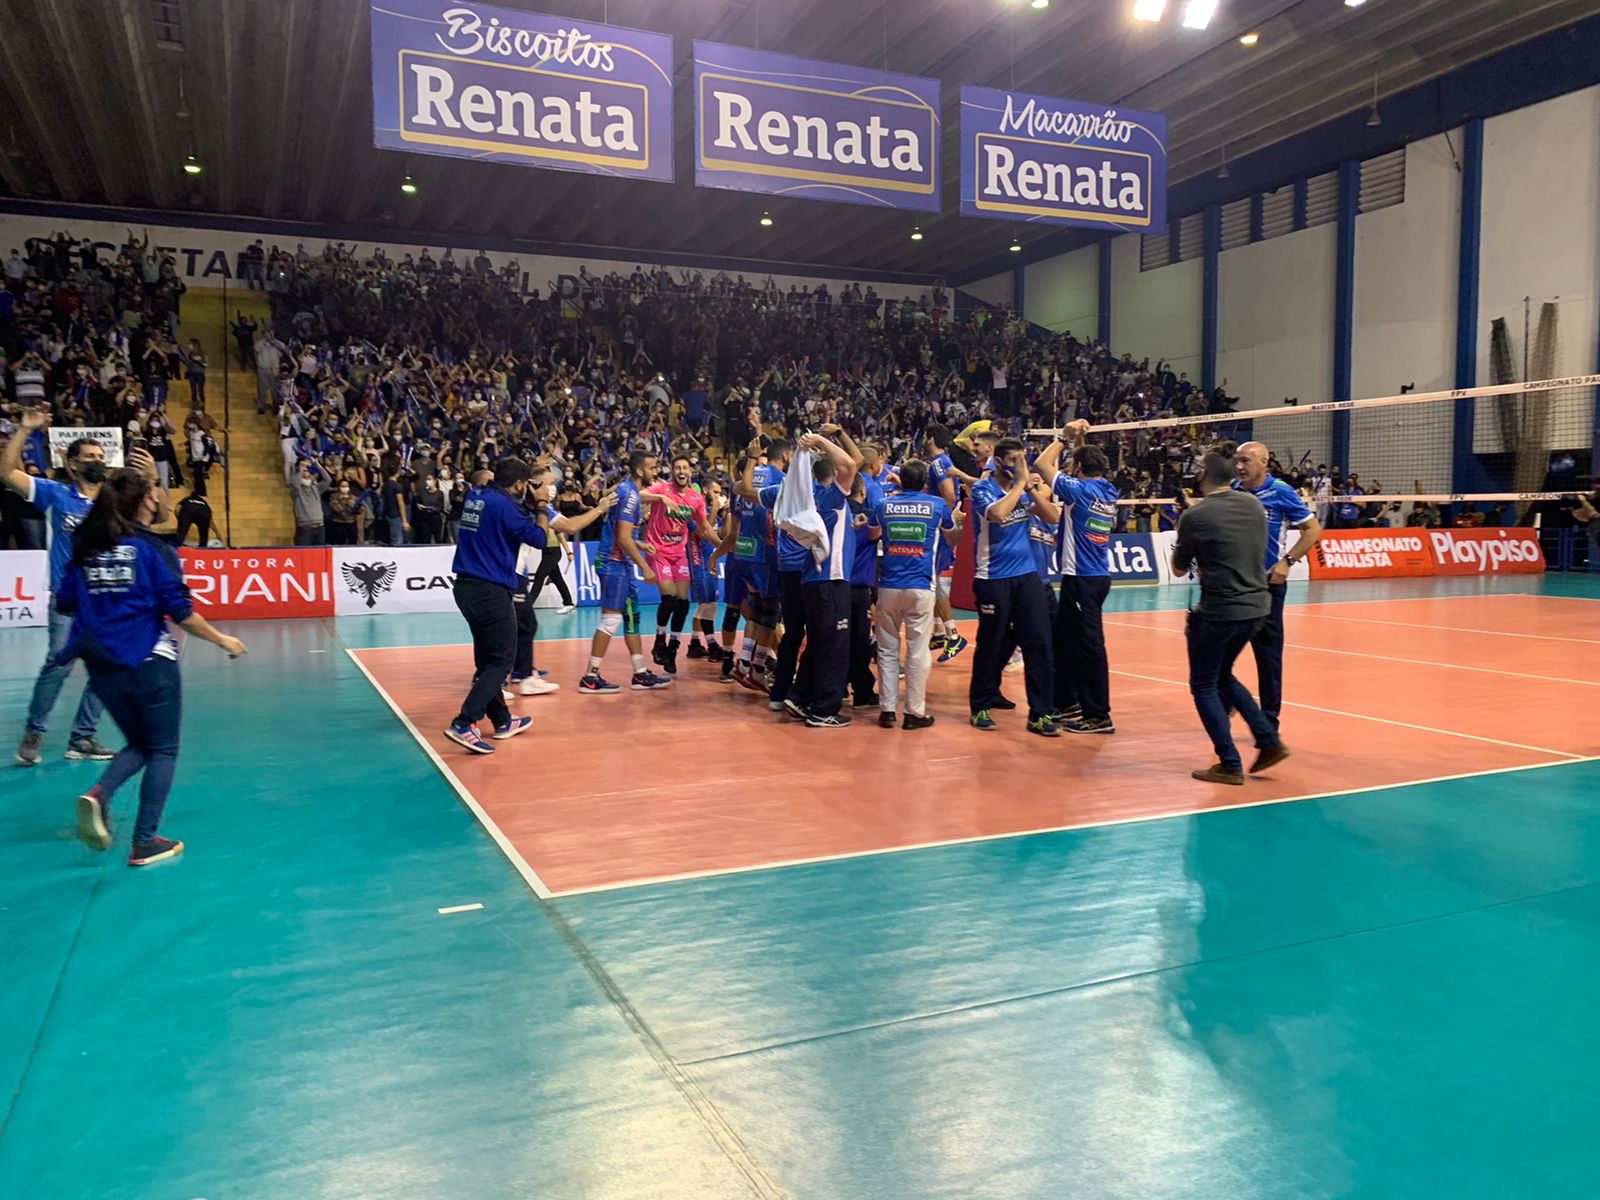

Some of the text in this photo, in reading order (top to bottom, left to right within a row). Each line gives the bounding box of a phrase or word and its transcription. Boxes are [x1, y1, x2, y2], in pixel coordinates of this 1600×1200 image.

[435, 8, 615, 72] Biscoitos
[410, 63, 639, 152] Renata
[999, 94, 1136, 143] Macarrão
[713, 90, 923, 172] Renata
[983, 144, 1144, 211] Renata
[1523, 377, 1581, 390] CAMPEONATO
[1311, 403, 1336, 411] MASTER
[885, 503, 931, 515] Renata
[1321, 536, 1422, 554] CAMPEONATO
[1323, 552, 1392, 569] PAULISTA
[1429, 530, 1539, 571] Playpiso
